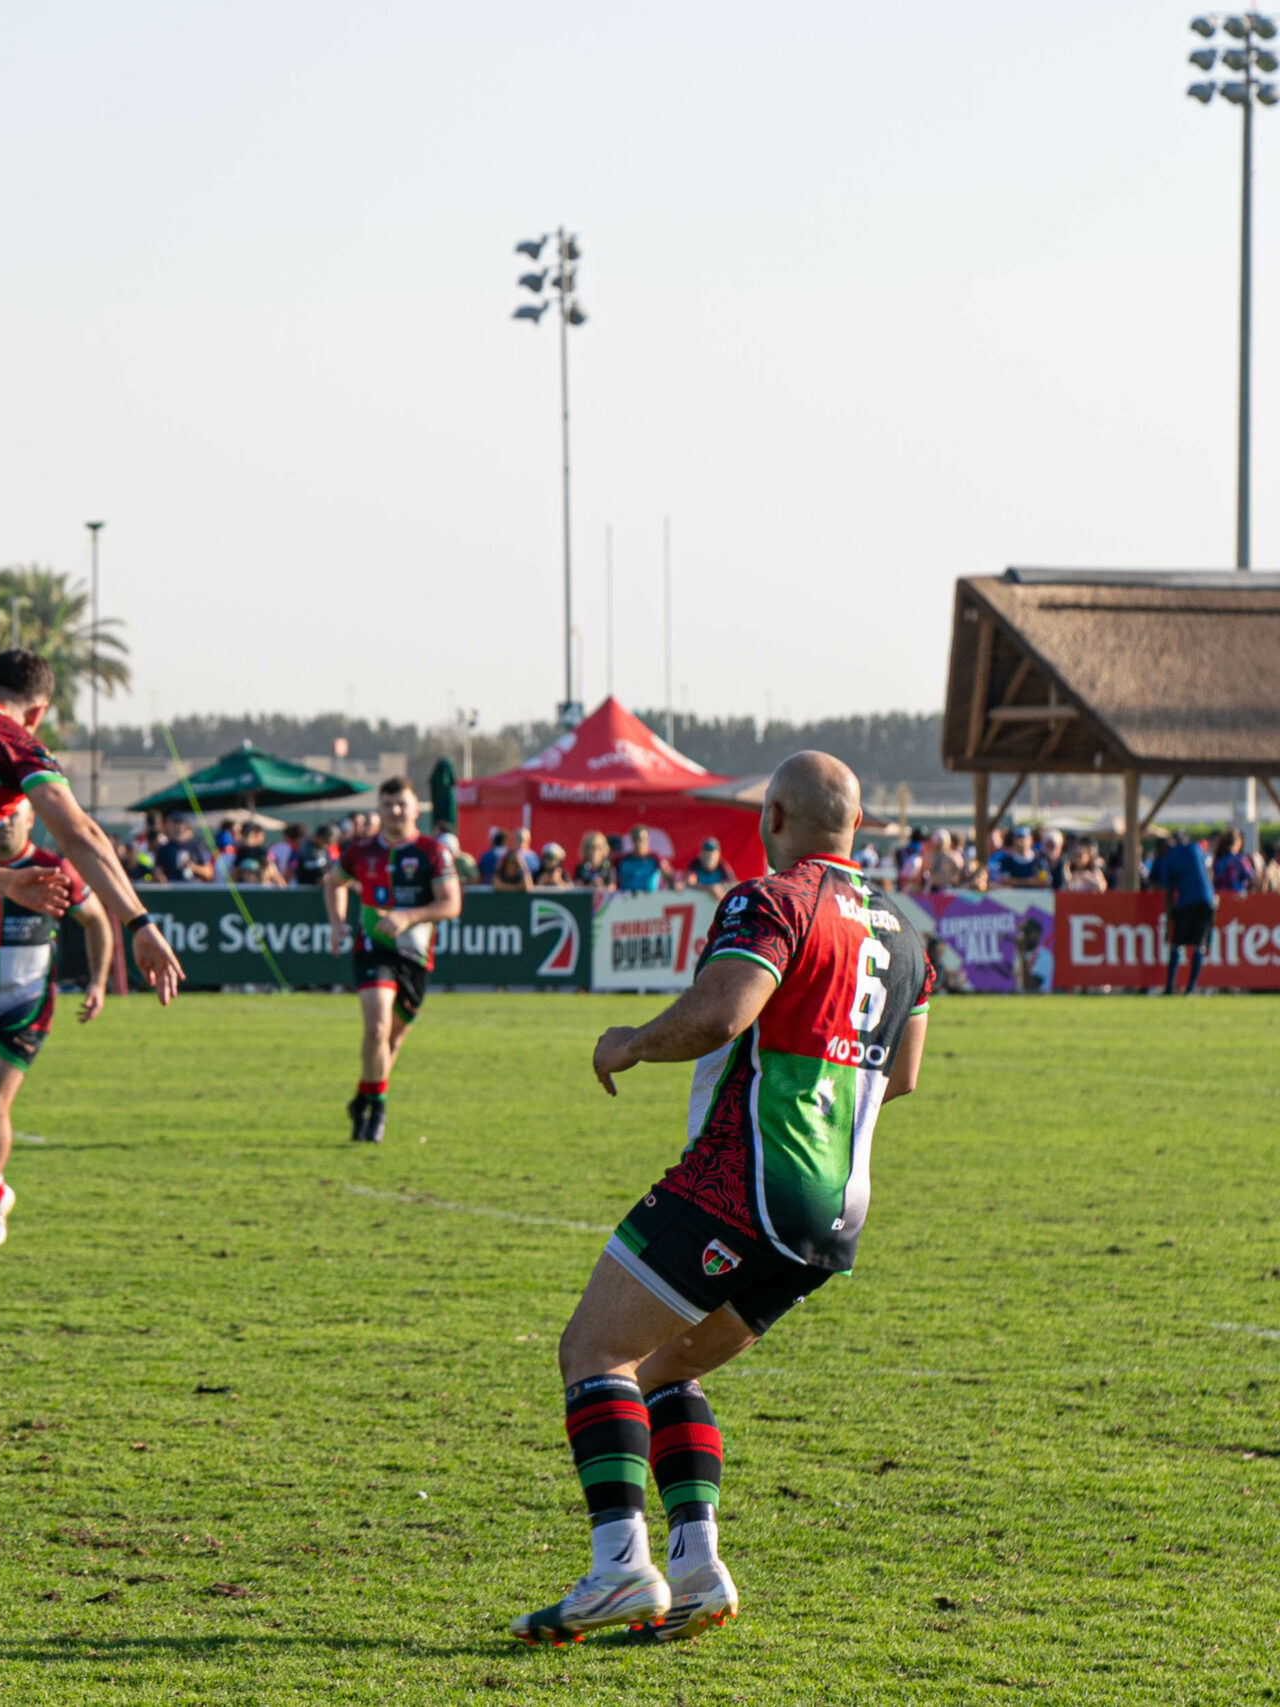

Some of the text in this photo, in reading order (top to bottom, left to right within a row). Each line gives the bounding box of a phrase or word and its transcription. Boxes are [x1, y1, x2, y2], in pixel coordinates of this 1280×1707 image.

[219, 913, 354, 953] Sevens
[966, 931, 1004, 965] ALL
[612, 935, 673, 973] DUBAI
[849, 936, 891, 1032] 6
